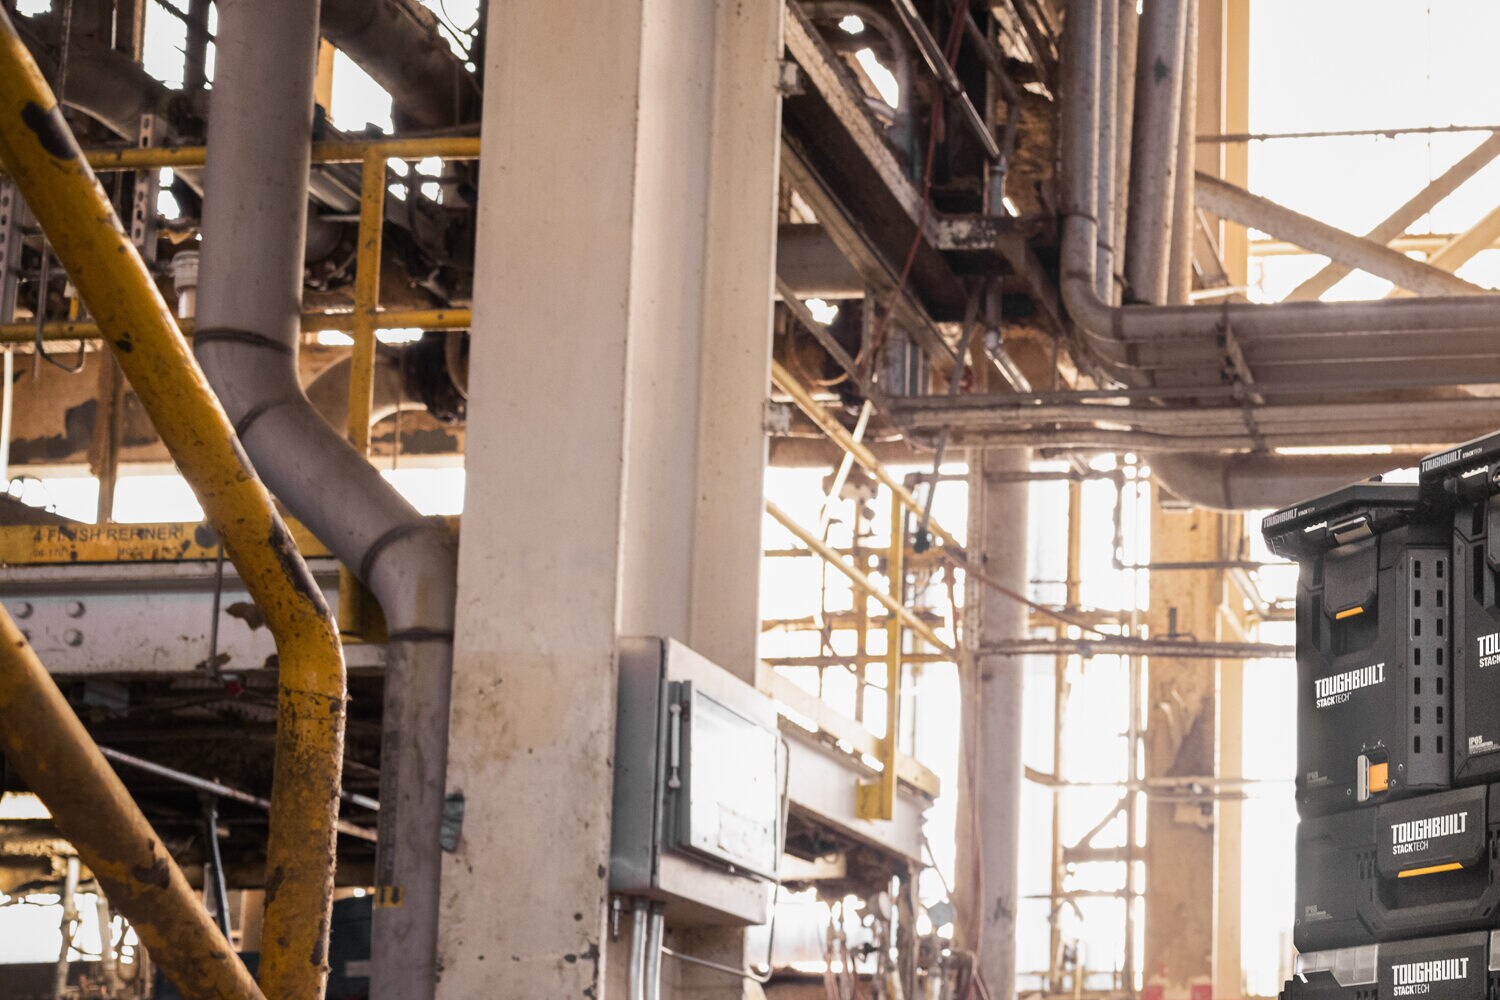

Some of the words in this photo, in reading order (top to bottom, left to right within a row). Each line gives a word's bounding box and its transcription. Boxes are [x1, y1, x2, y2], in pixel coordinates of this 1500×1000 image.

[1422, 449, 1462, 472] TOUGHBUILT
[1262, 508, 1297, 528] TOUGHBUILT
[48, 526, 101, 541] FIISH
[1315, 663, 1385, 698] TOUGHBUILT
[1316, 692, 1351, 708] STACKTECH
[1391, 812, 1468, 844] TOUGHBUILT
[1392, 840, 1429, 855] STACKTECH
[1392, 957, 1469, 986] TOUGHBUILT
[1393, 983, 1430, 996] STACKTECH
